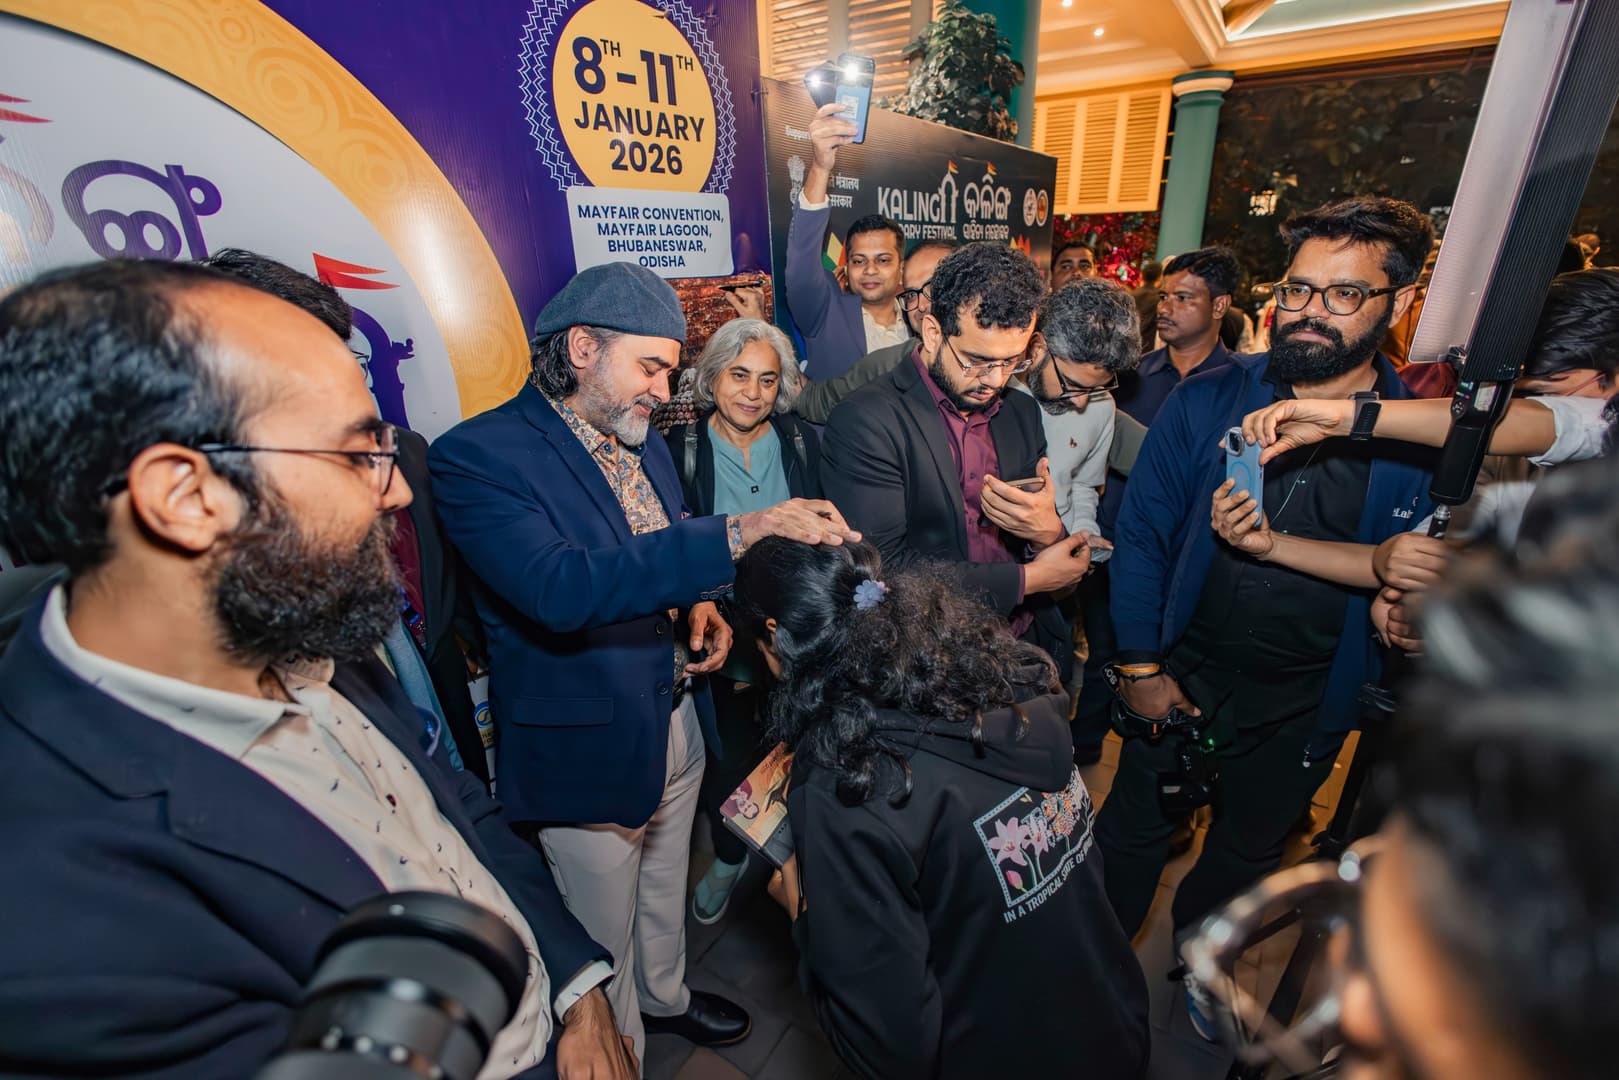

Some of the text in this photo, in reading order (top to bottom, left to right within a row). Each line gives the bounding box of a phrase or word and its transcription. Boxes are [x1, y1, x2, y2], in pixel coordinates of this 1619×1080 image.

[574, 101, 705, 143] JANUARY
[609, 138, 683, 175] 2026
[577, 204, 724, 223] MAYFAIR CONVENTION,
[597, 222, 712, 239] MAYFAIR LAGOON,
[922, 224, 957, 240] FESTIVAL
[608, 239, 707, 253] BHUBANESWAR,
[639, 255, 686, 268] ODISHA
[1003, 850, 1085, 923] IN A TROPICAL STATE OF
